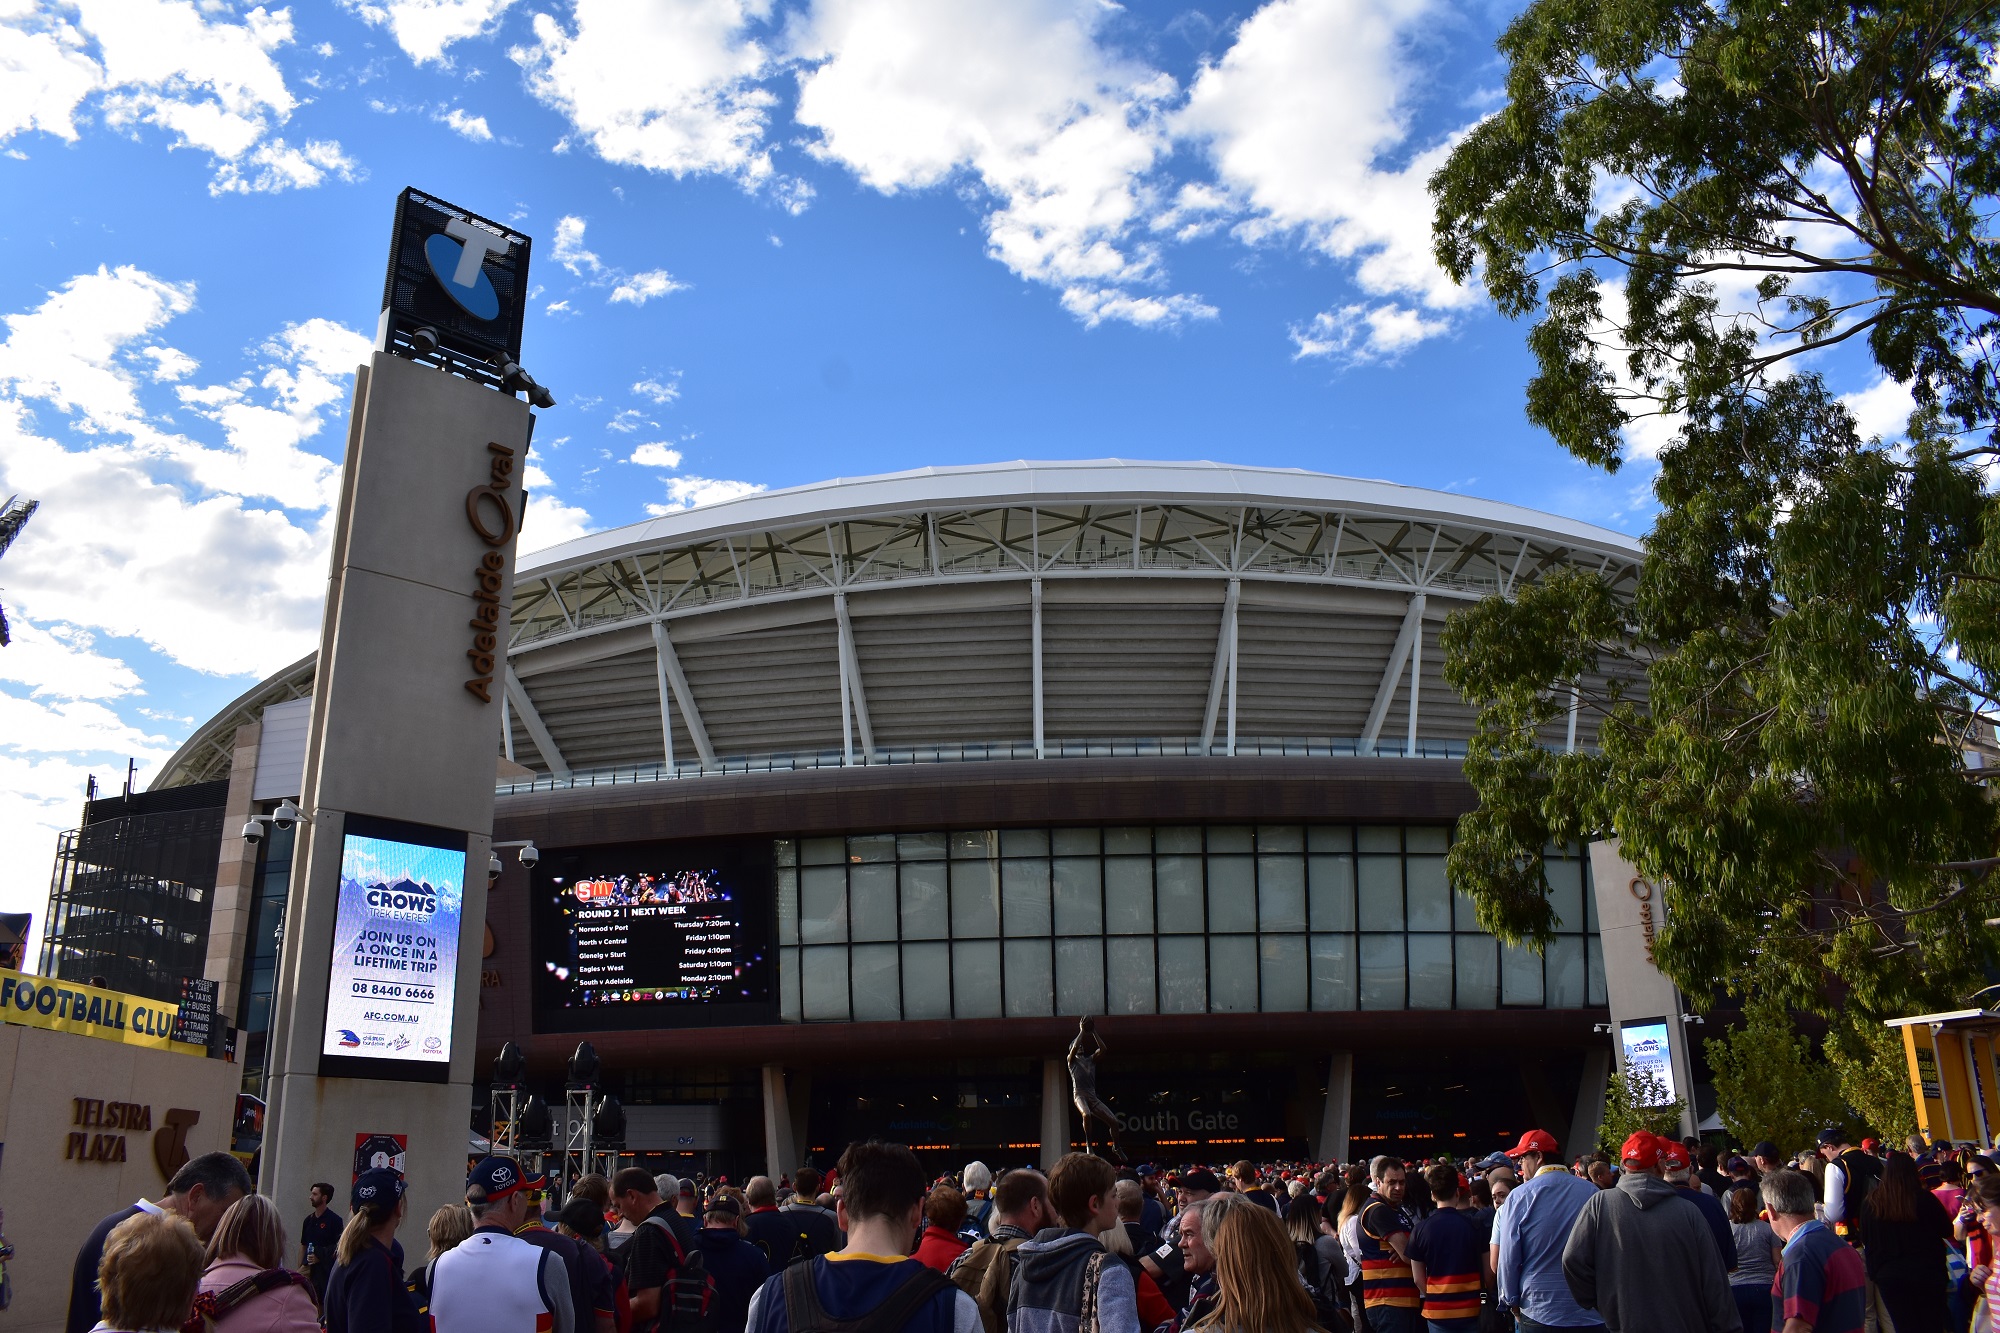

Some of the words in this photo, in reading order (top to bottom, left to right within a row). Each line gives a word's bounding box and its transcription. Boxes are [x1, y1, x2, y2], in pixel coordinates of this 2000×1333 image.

[465, 441, 514, 547] Oval
[464, 550, 505, 703] Adelaide
[367, 890, 436, 913] CROWS
[370, 908, 392, 919] TREK
[394, 910, 432, 924] EVEREST
[578, 910, 612, 919] ROUND
[613, 909, 620, 918] 2
[631, 907, 656, 917] NEXT
[658, 906, 687, 915] WEEK
[578, 925, 608, 933] Norwood
[674, 921, 704, 929] Thursday
[359, 930, 393, 943] JOIN
[396, 935, 412, 945] US
[416, 936, 436, 948] ON
[1639, 902, 1659, 965] Adelaide
[355, 943, 365, 953] A
[369, 944, 408, 957] ONCE
[412, 948, 425, 959] IN
[428, 951, 438, 960] A
[354, 955, 407, 971] LIFETIME
[411, 961, 438, 973] TRIP
[678, 961, 708, 969] Saturday
[195, 992, 211, 1002] TAXIS
[352, 982, 367, 993] 08
[371, 984, 401, 996] 8440
[405, 987, 435, 999] 6666
[0, 977, 125, 1030] FOOTBALL
[132, 1006, 177, 1038] CLU
[191, 1001, 211, 1012] BUSES
[190, 1011, 210, 1021] TRAINS
[363, 1011, 419, 1023] AFC.COM.AU
[190, 1021, 209, 1032] TRAMS
[183, 1030, 209, 1039] RIVERBANK
[186, 1037, 204, 1045] BRIDGE
[1633, 1045, 1660, 1053] CROWS
[1920, 1071, 1937, 1081] HIRE
[73, 1097, 152, 1131] TELSTRA
[888, 1119, 936, 1130] Adelaide
[1114, 1110, 1179, 1132] South
[1188, 1110, 1239, 1131] Gate
[66, 1132, 126, 1163] PLAZA
[494, 1178, 517, 1191] TOYOTA
